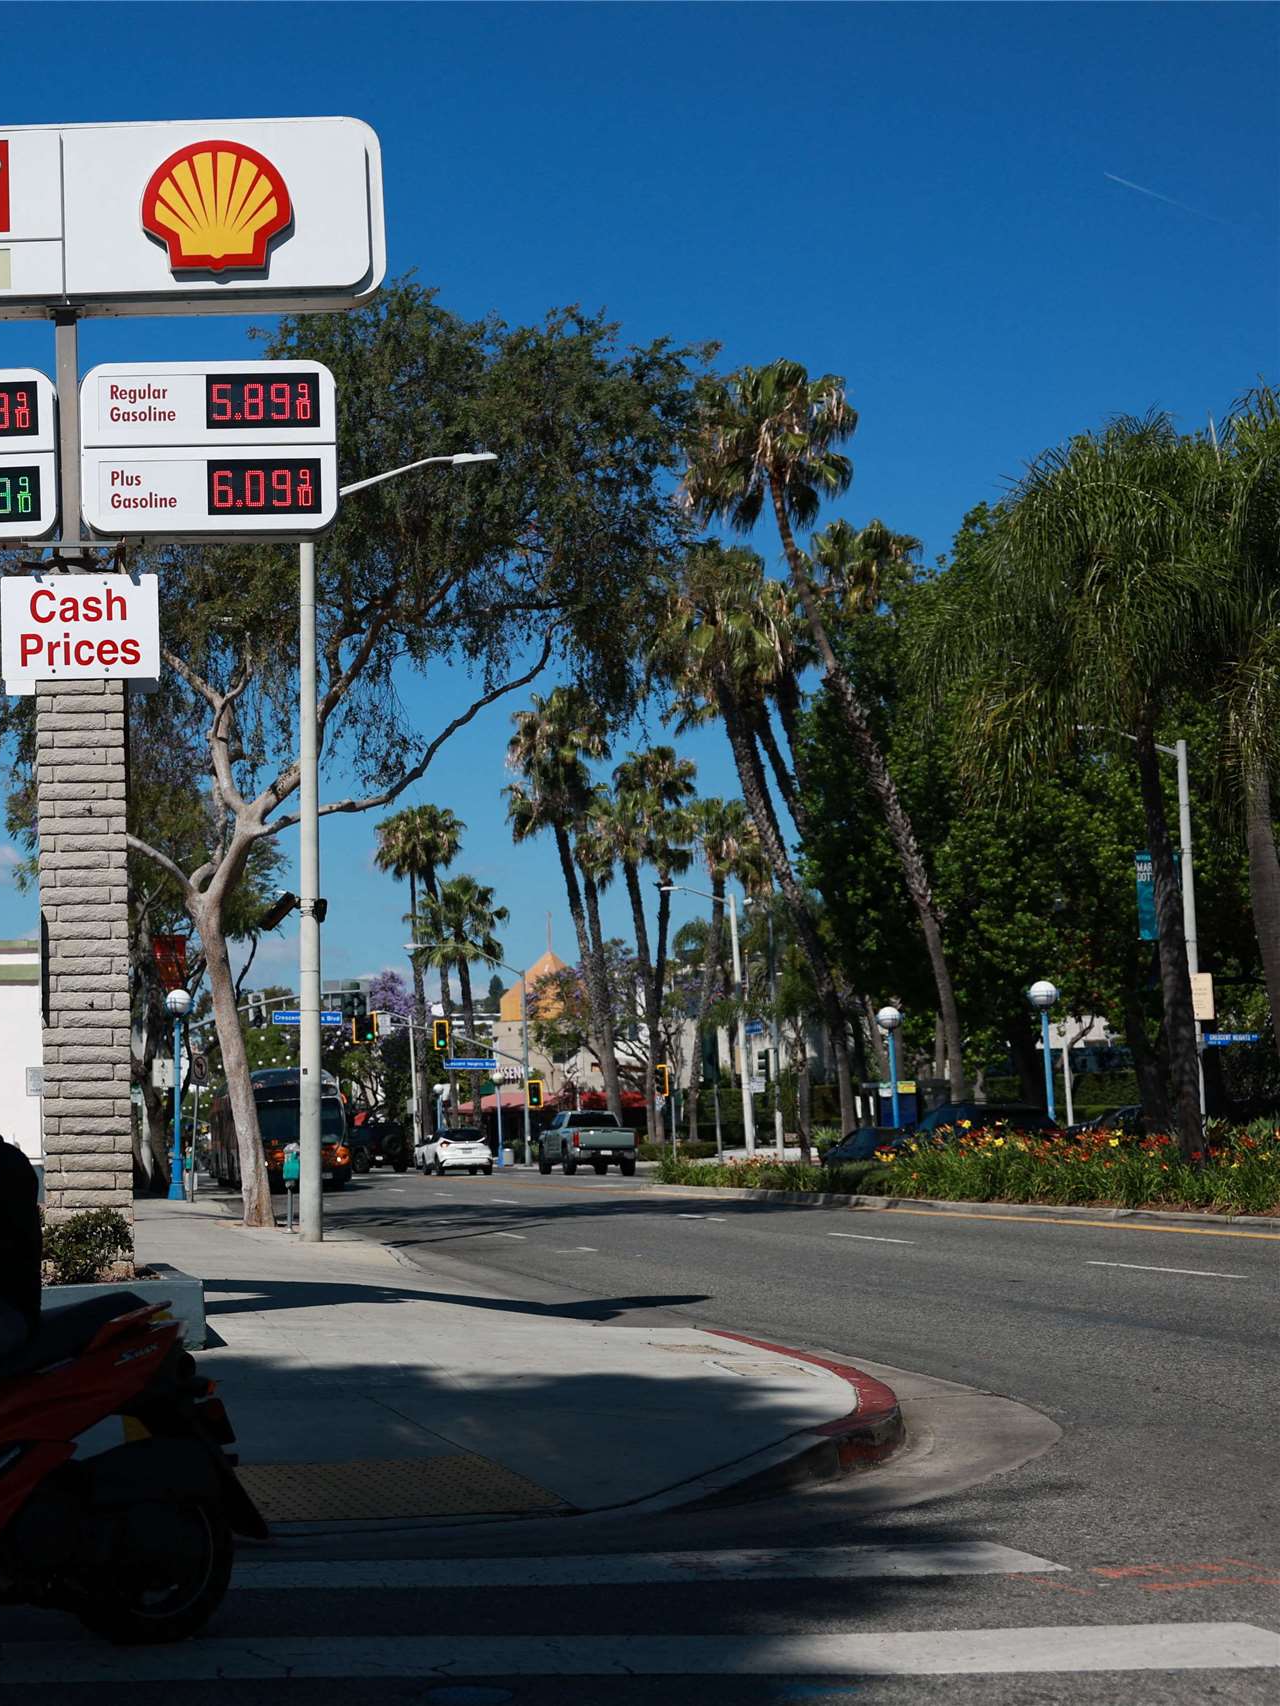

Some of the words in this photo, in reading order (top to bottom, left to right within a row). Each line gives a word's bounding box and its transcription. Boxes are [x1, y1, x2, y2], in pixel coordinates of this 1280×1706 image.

[110, 383, 168, 404] Regular
[110, 406, 176, 422] Gasoline
[111, 471, 141, 486] Plus
[111, 492, 177, 508] Gasoline
[30, 588, 127, 623] Cash
[20, 632, 141, 667] Prices
